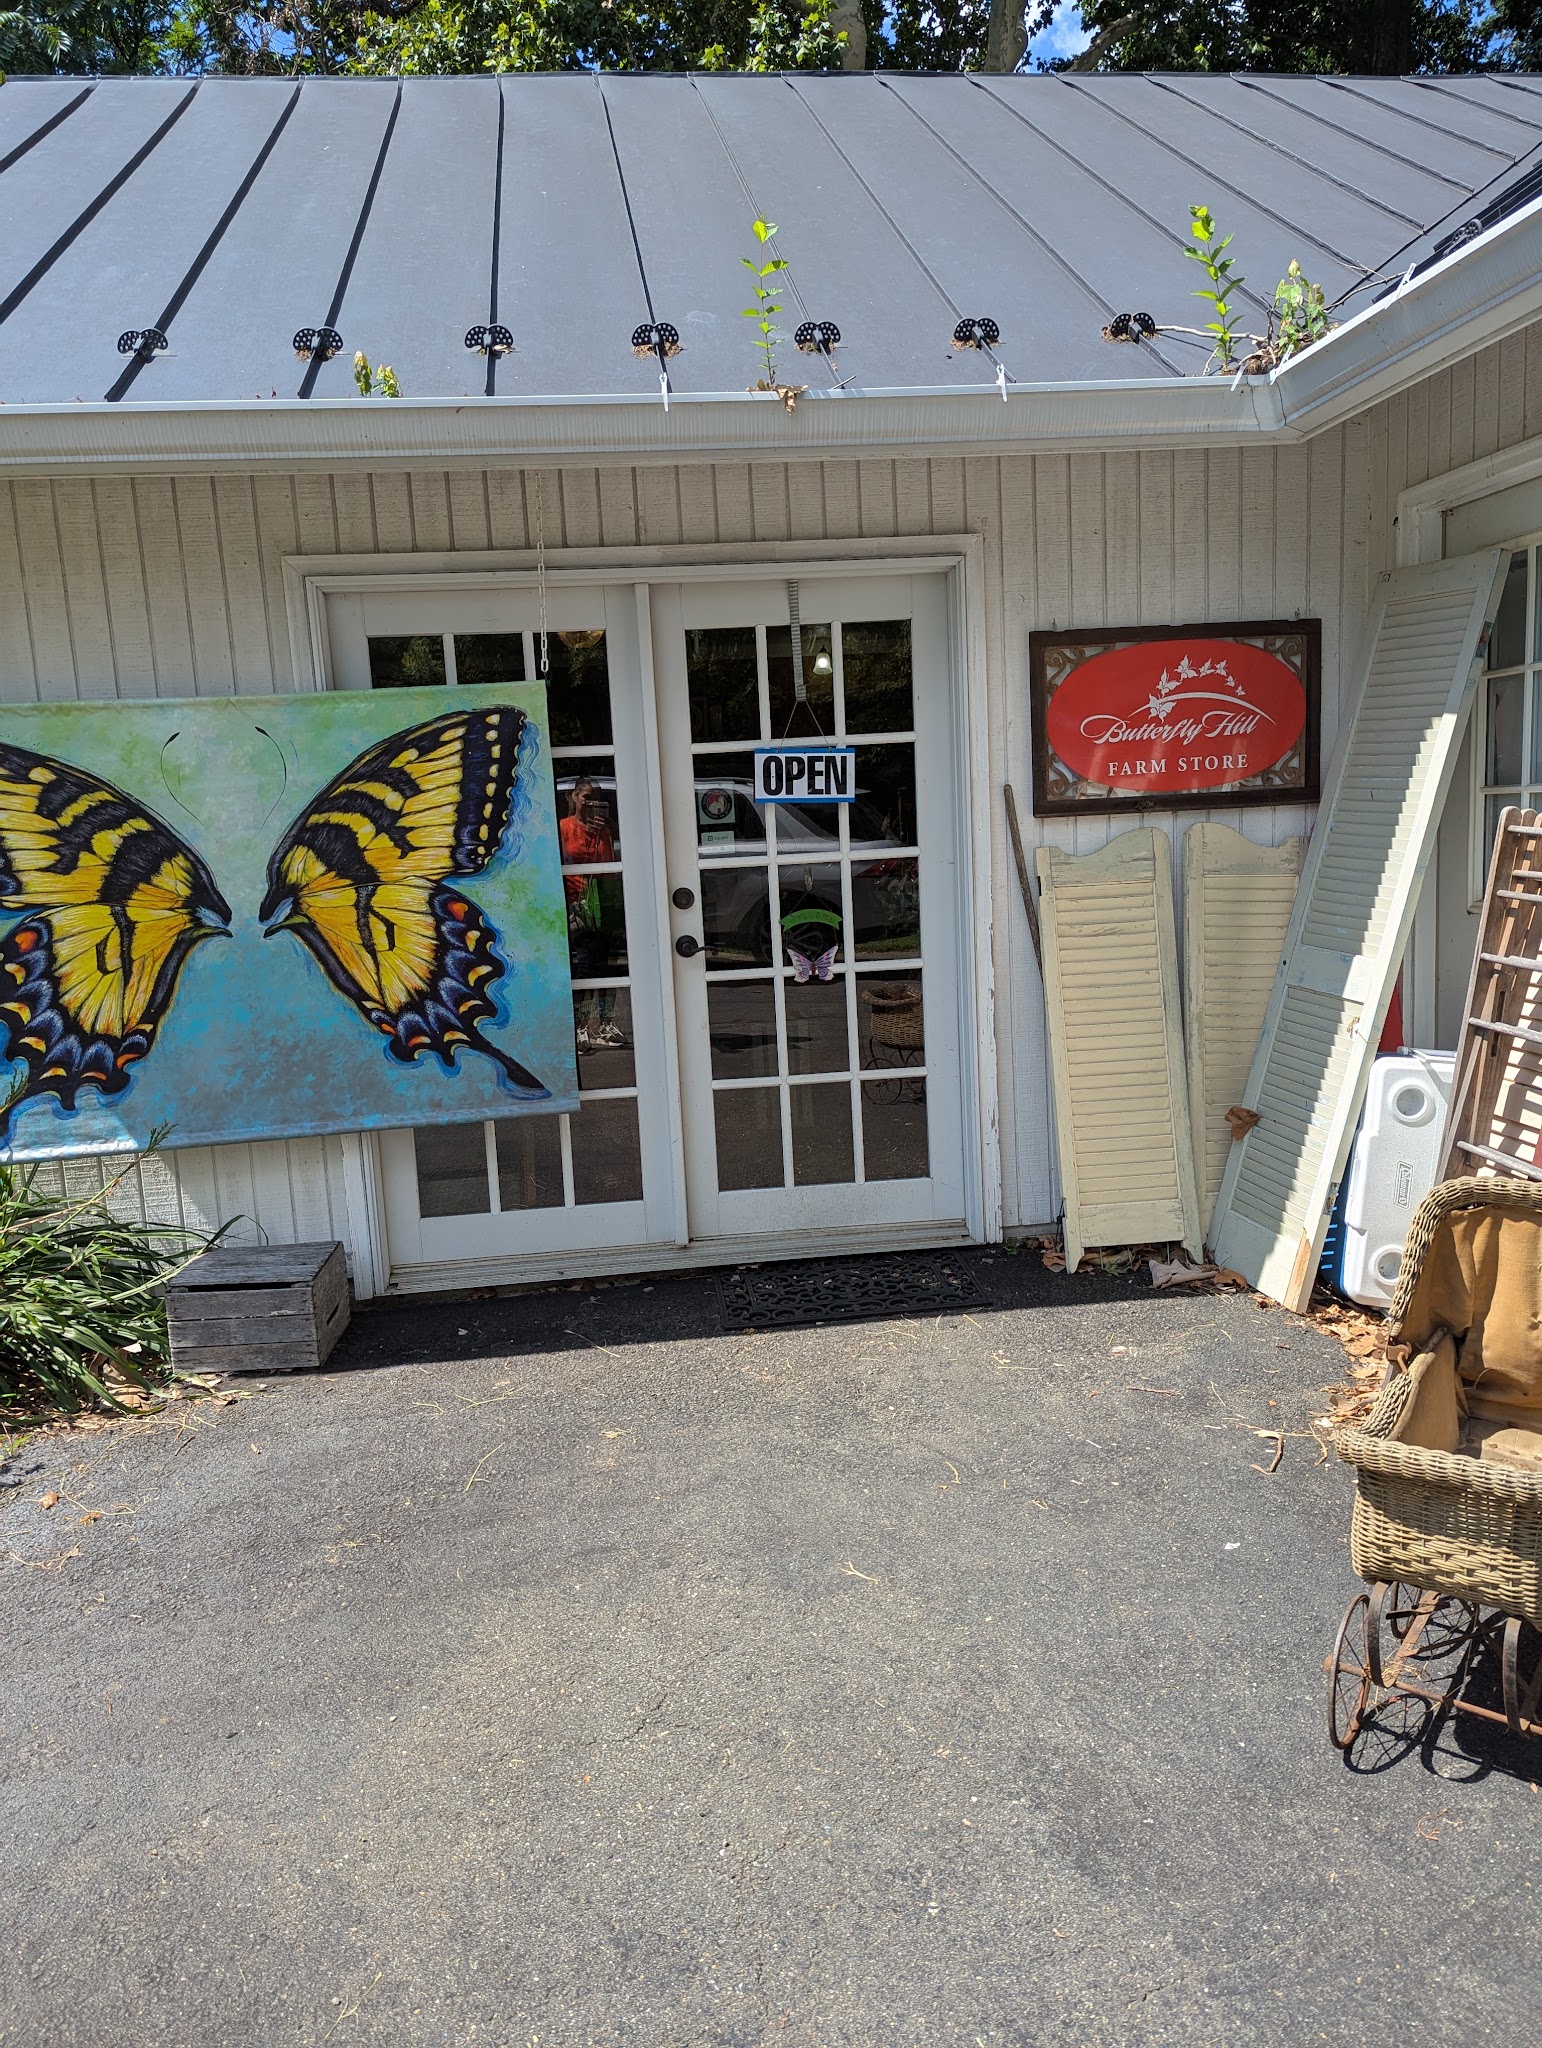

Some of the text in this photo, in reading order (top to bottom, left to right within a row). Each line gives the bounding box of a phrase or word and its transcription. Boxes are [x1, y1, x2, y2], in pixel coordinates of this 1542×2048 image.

[1080, 710, 1261, 746] Butterfly Hill
[762, 755, 848, 796] OPEN
[1108, 754, 1249, 777] FARM STORE
